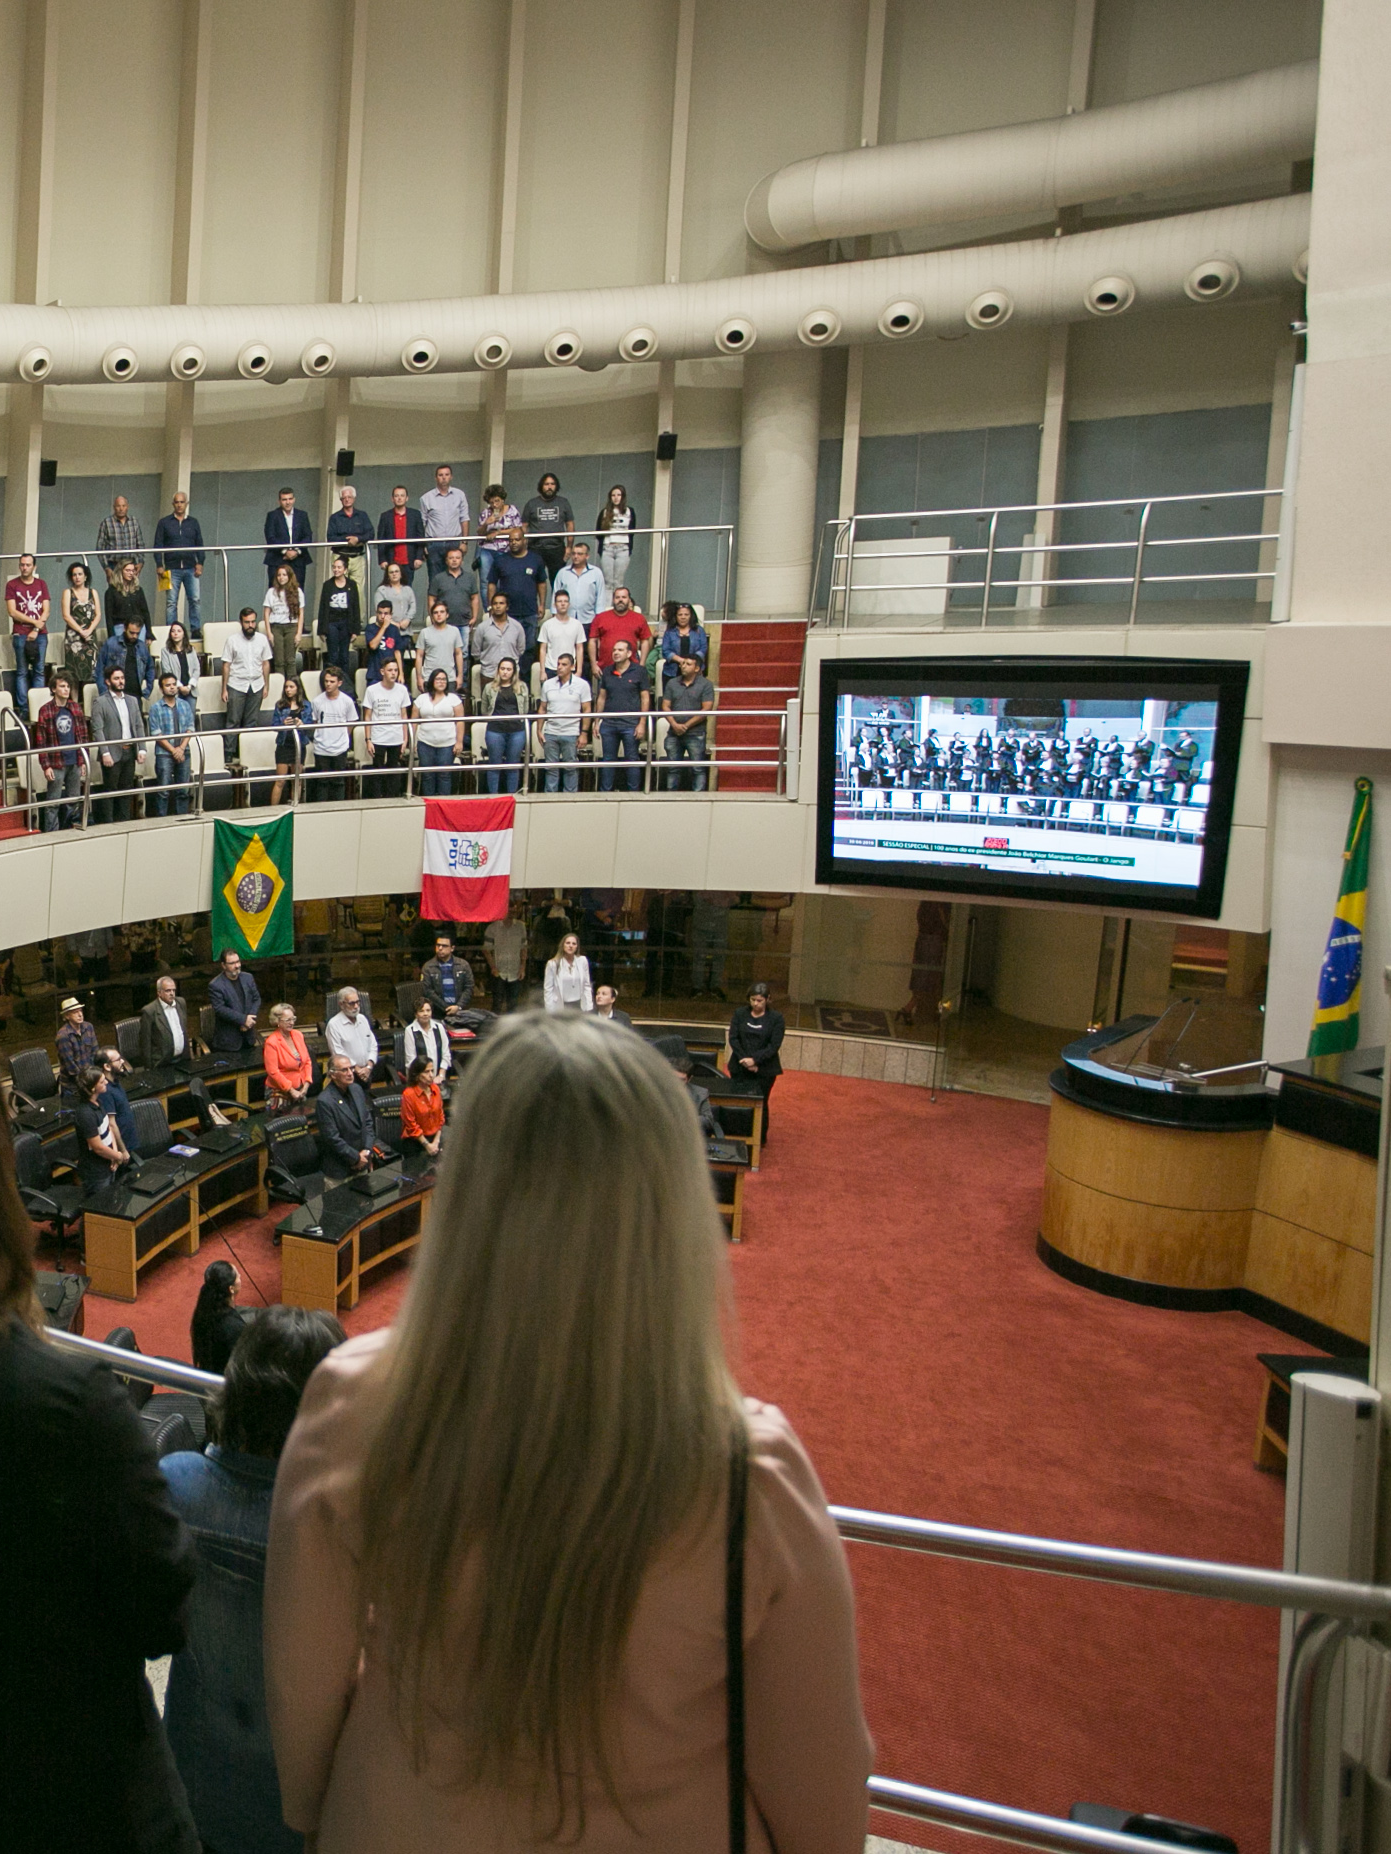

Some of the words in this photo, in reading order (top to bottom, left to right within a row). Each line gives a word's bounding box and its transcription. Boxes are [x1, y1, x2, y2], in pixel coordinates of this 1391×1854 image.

[448, 838, 459, 870] PDT
[882, 840, 904, 848] SESSÃO
[904, 842, 930, 850] ESPECIAL
[976, 848, 1007, 857] presidente
[1023, 851, 1047, 859] Belchior
[1047, 853, 1074, 862] Marques
[1075, 855, 1098, 863] Goulart
